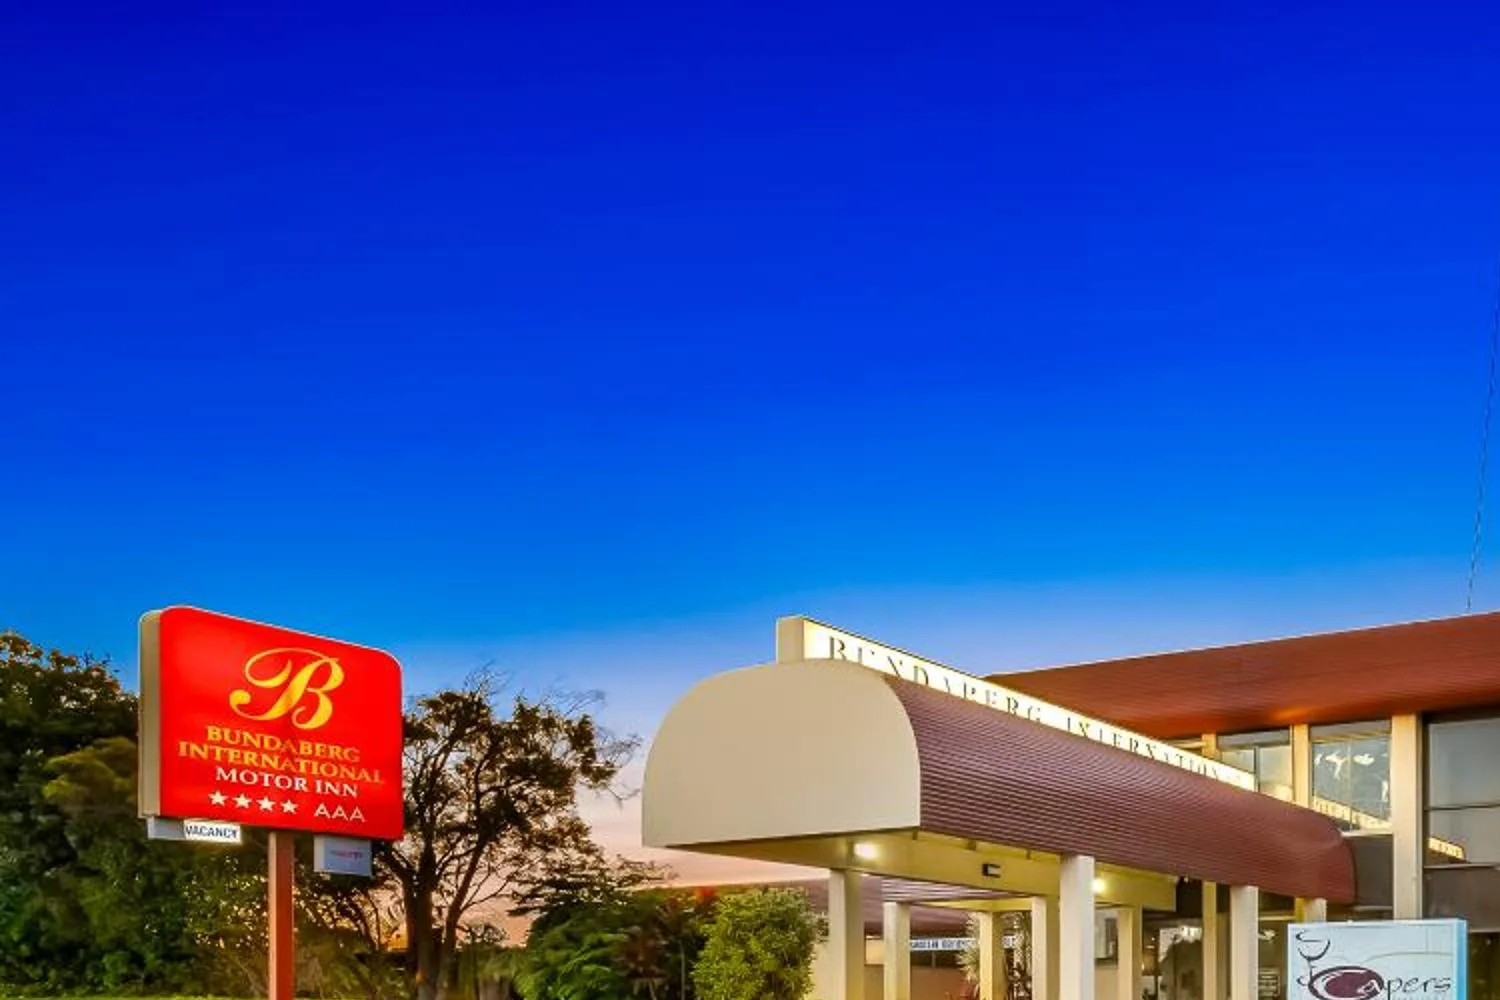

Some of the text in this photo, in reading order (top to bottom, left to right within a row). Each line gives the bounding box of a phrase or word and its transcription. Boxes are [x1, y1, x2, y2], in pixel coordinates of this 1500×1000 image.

[229, 647, 344, 730] B
[206, 725, 360, 762] BUNDABERG
[178, 741, 384, 784] INTERNATIONAL
[215, 766, 358, 799] MOTOR INN
[314, 803, 366, 822] AAA
[185, 825, 238, 839] VACANCY
